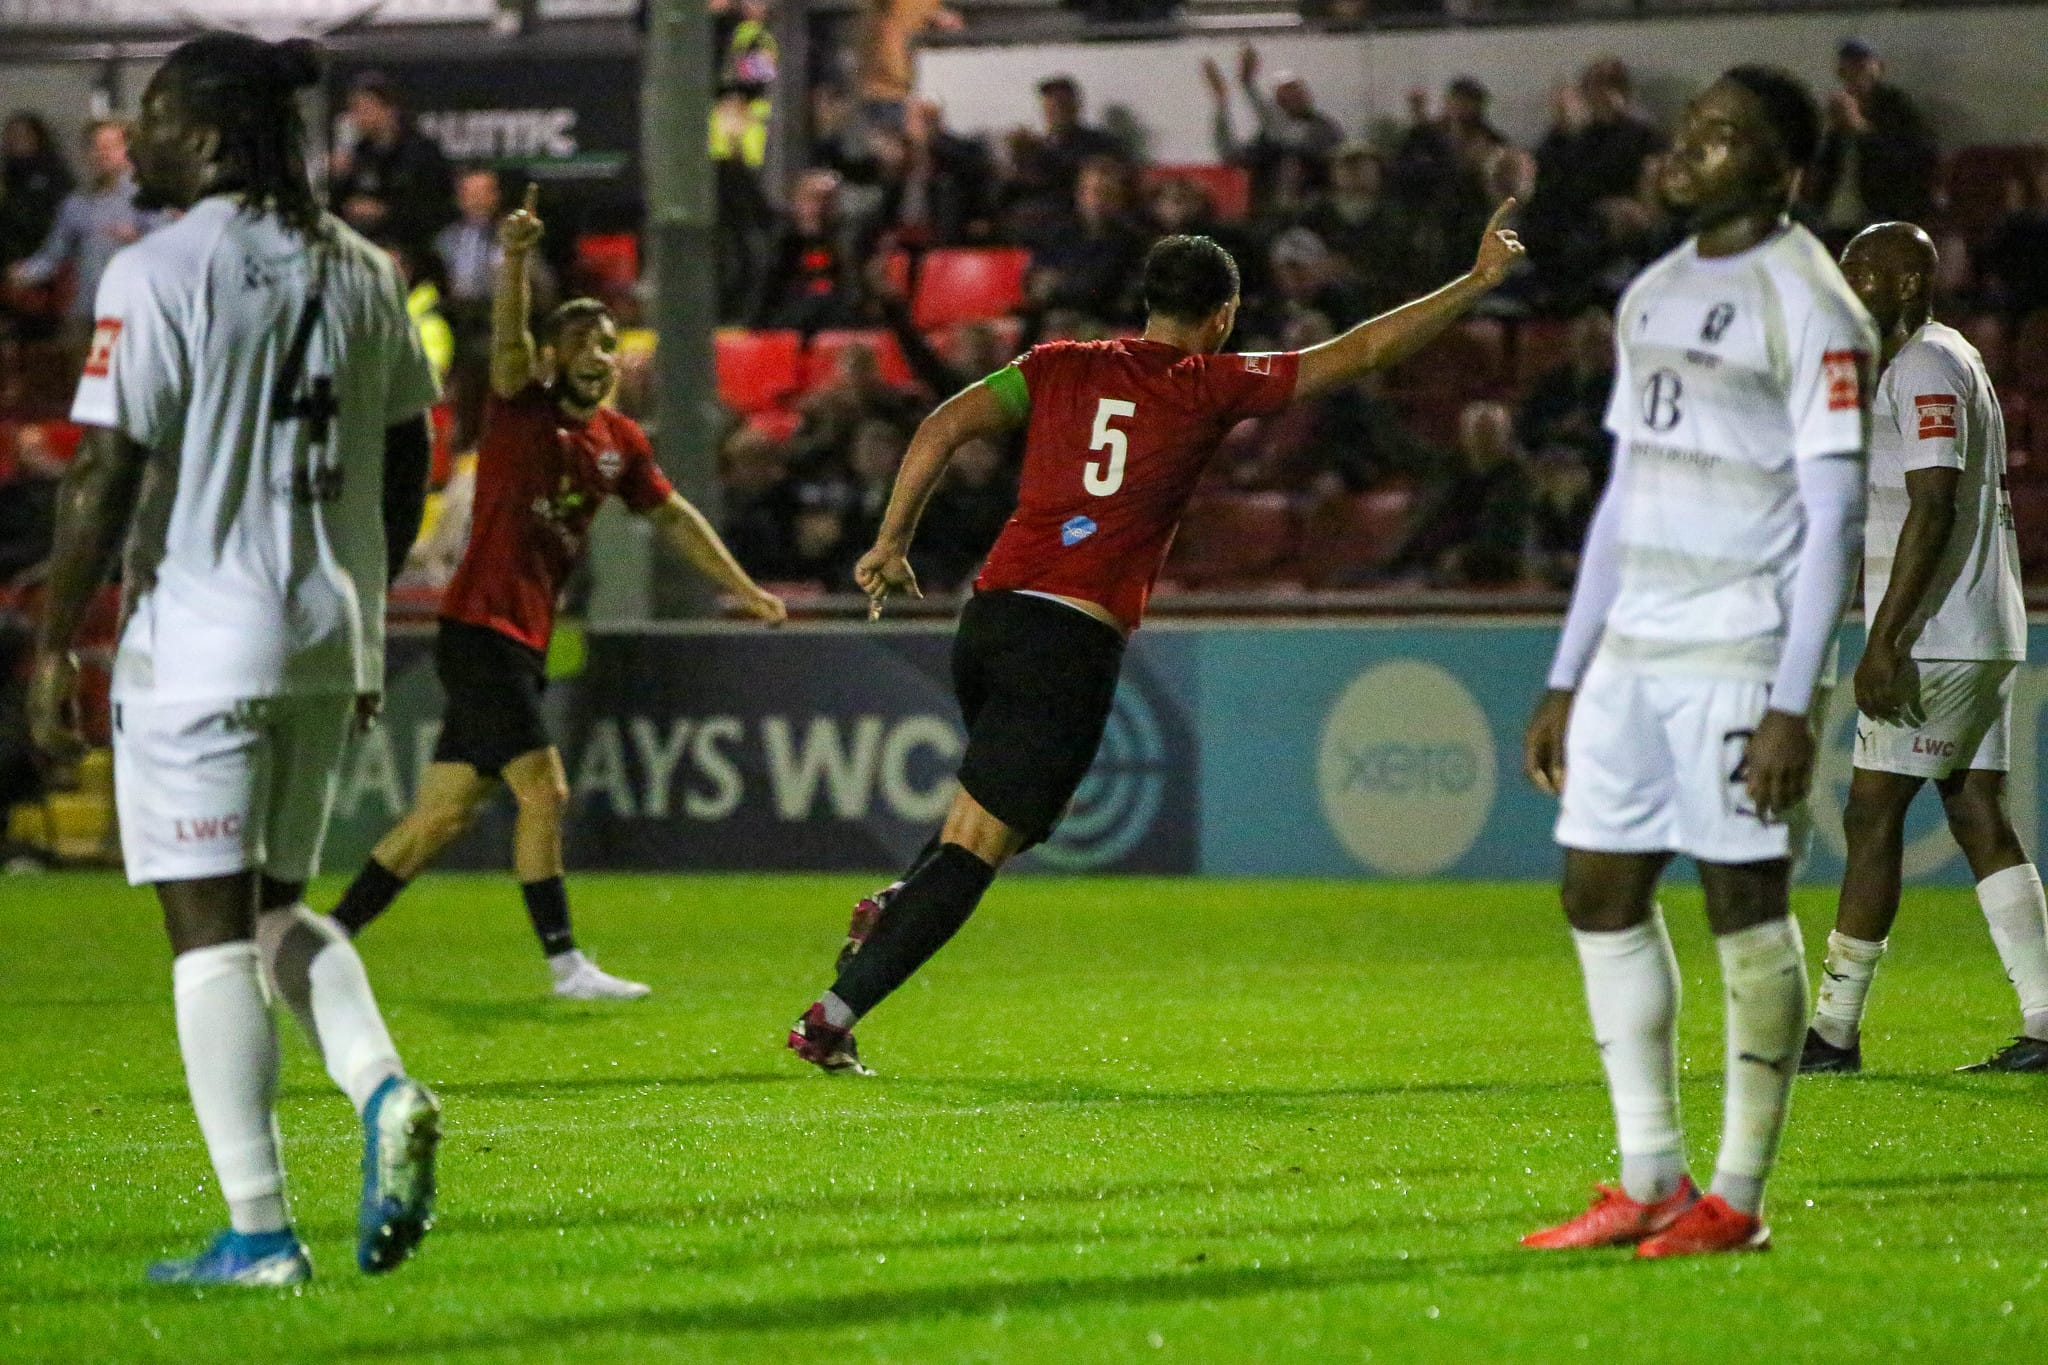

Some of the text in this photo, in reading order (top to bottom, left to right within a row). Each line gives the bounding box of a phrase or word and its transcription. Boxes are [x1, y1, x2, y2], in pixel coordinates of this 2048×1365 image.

[270, 292, 338, 446] 4
[1083, 398, 1137, 497] 5
[1337, 741, 1479, 796] xero
[1912, 735, 1956, 758] LWC
[175, 813, 242, 843] LWC
